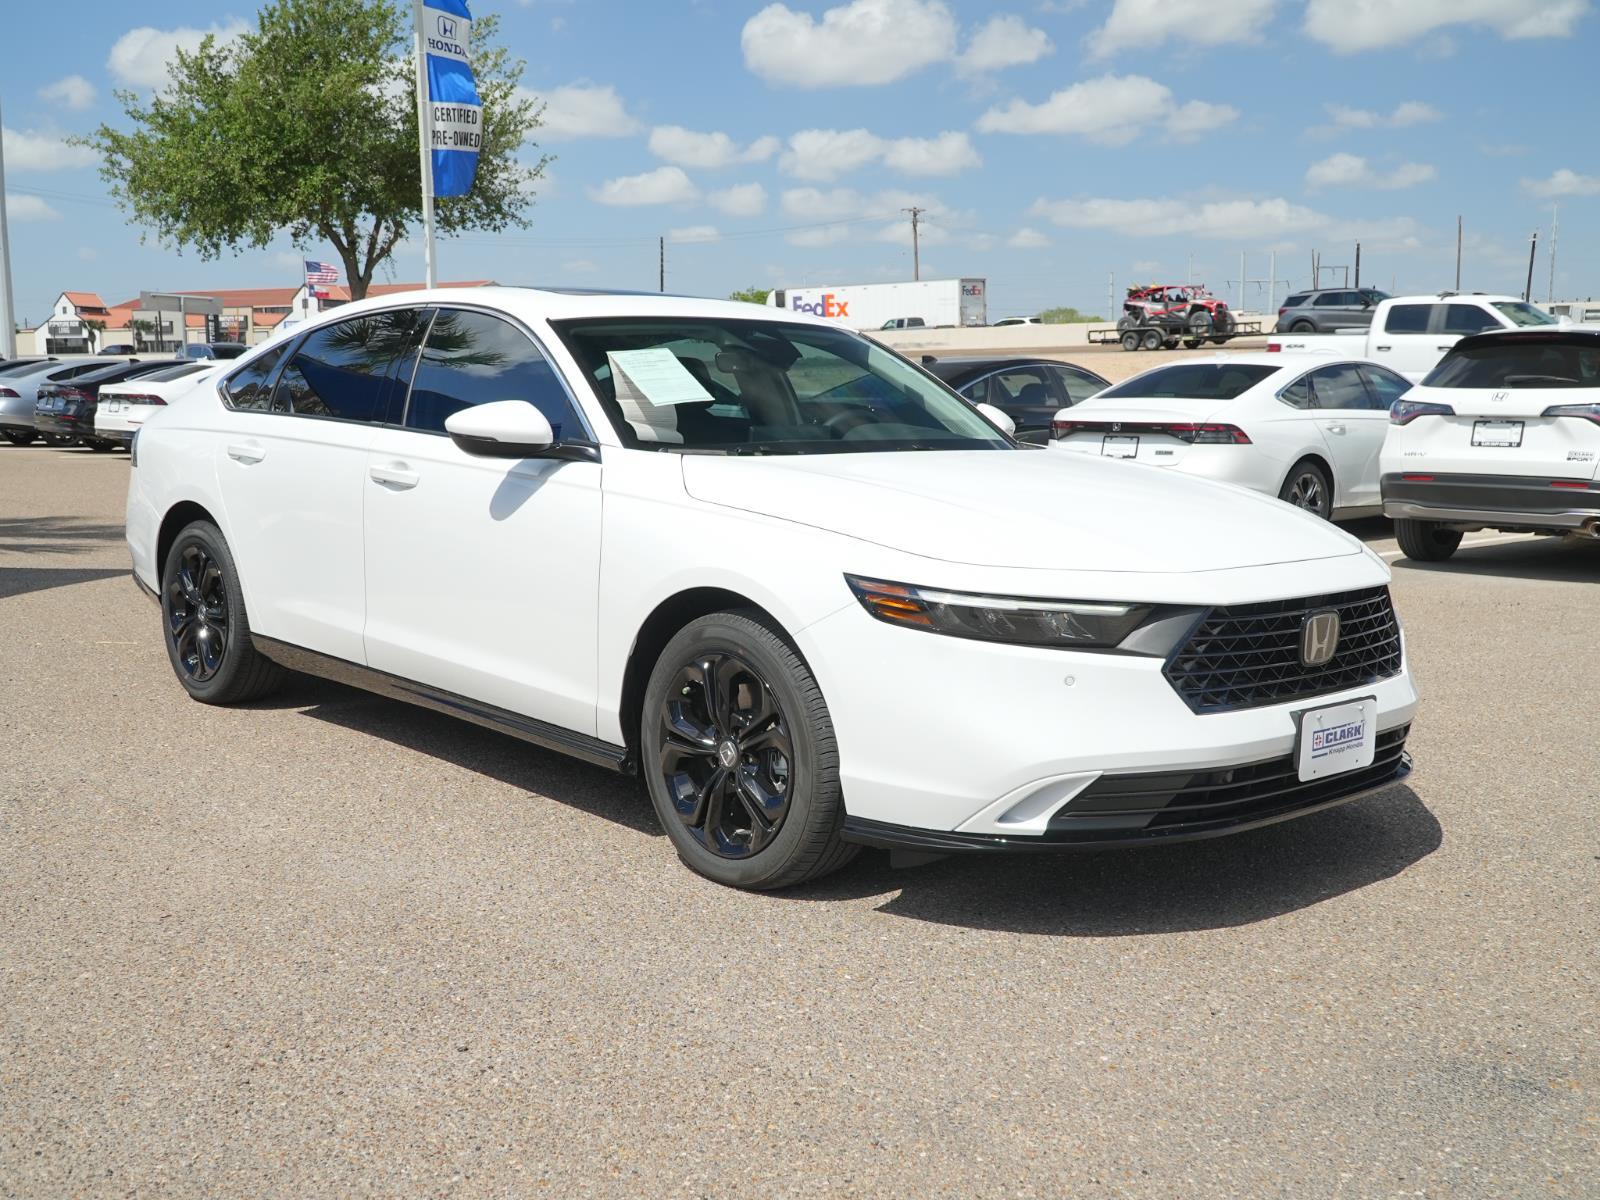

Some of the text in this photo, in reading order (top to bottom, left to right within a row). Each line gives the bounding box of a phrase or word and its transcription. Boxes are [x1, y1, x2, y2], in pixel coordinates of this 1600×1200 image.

[428, 38, 468, 59] HONDA
[434, 107, 477, 125] CERTIFIED
[432, 130, 480, 148] PRE-OWNED
[962, 285, 982, 297] FedEx
[793, 294, 849, 317] FedEx
[1325, 725, 1362, 744] CLARK
[1329, 742, 1364, 755] Knapp Honda
